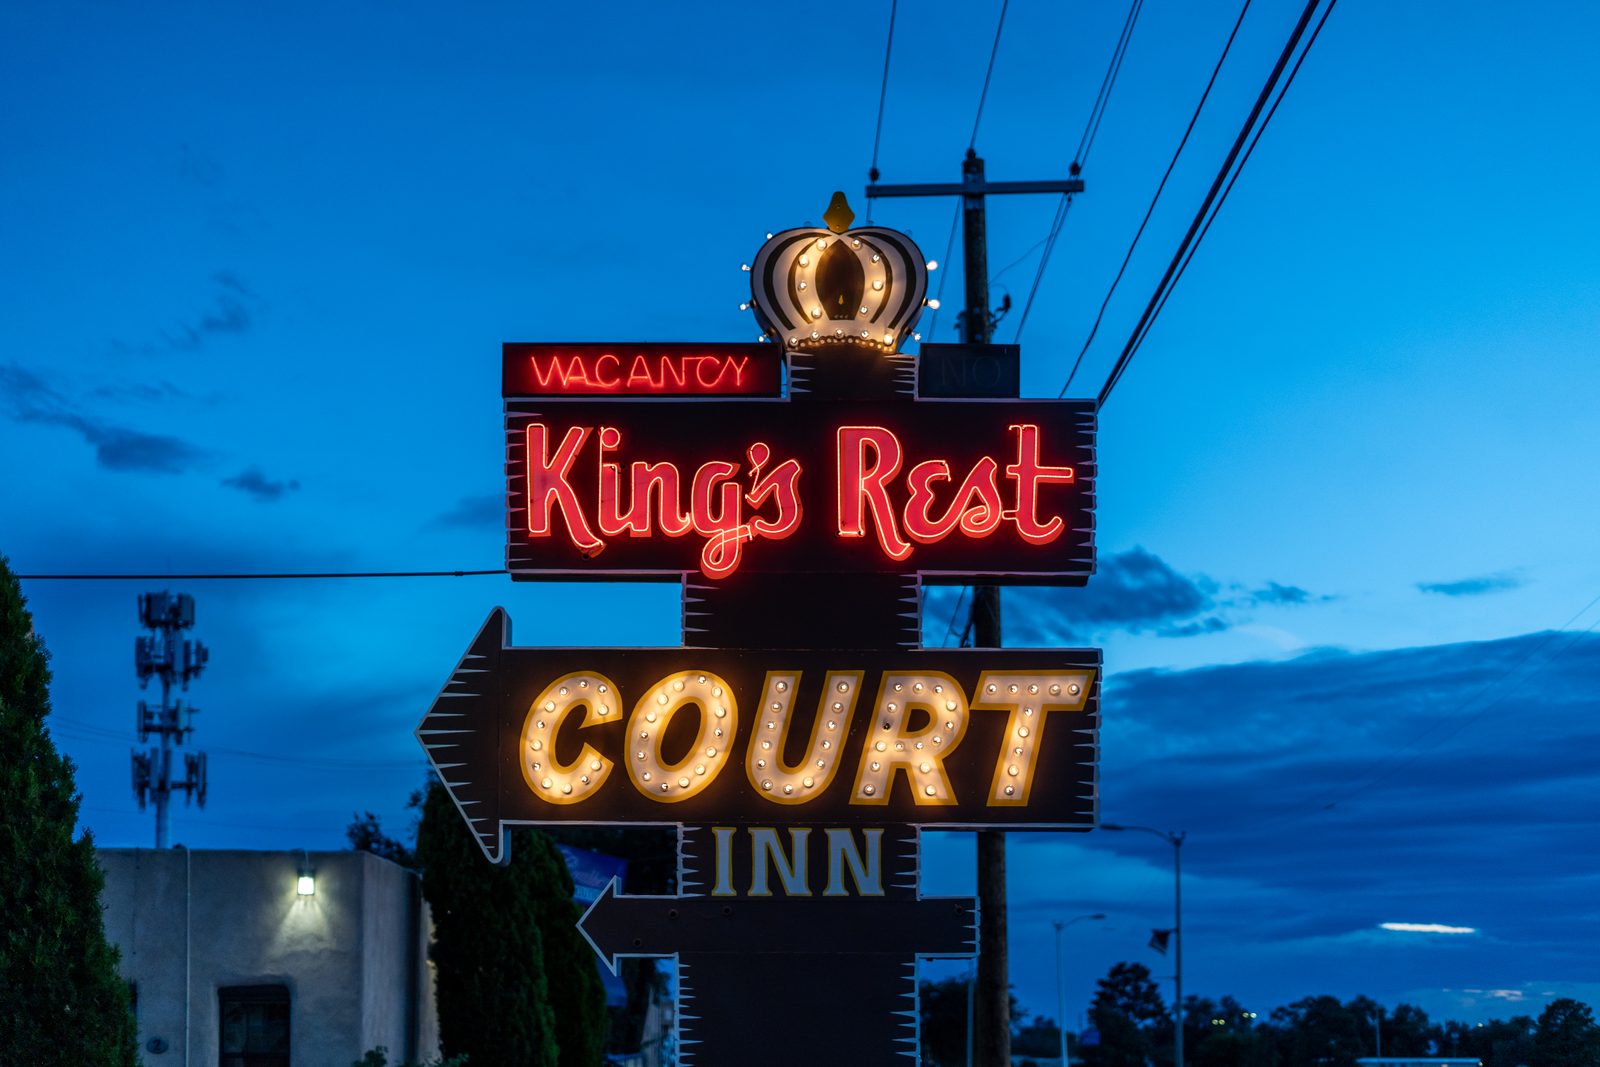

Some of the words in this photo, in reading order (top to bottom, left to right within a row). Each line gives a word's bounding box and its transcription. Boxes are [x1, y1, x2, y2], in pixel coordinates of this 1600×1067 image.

[530, 354, 749, 388] VACANCY
[941, 355, 1002, 388] NO
[525, 422, 803, 580] King's
[836, 422, 1075, 562] Rest
[519, 669, 1095, 807] COURT
[710, 826, 886, 898] INN
